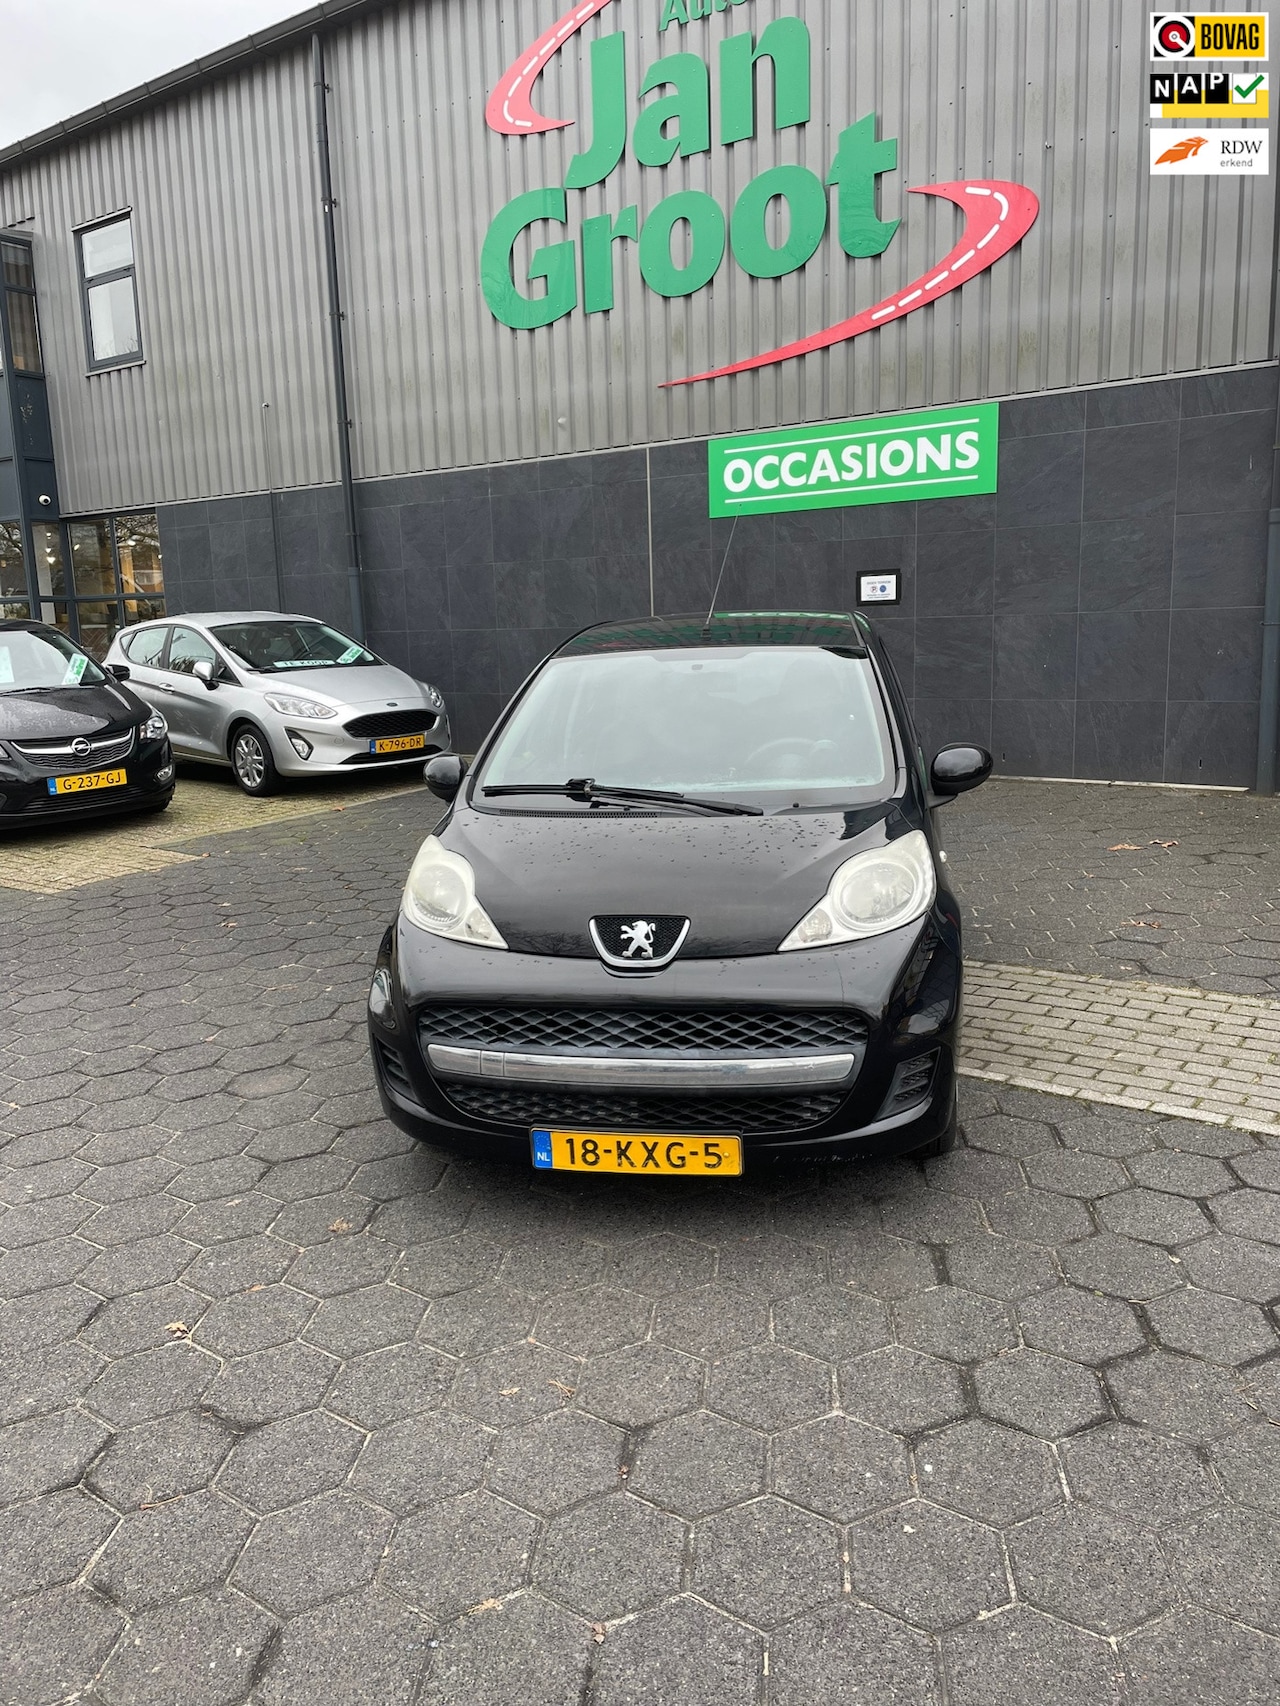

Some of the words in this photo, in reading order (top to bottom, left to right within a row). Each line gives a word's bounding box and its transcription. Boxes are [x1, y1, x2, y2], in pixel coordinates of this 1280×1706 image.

[565, 17, 810, 189] Jan
[481, 113, 901, 330] Groot
[723, 430, 980, 493] OCCASIONS
[379, 737, 422, 751] K-796-DR
[63, 772, 121, 790] G-237-GJ
[537, 1152, 550, 1162] NL
[565, 1138, 723, 1169] 18-KXG-5
